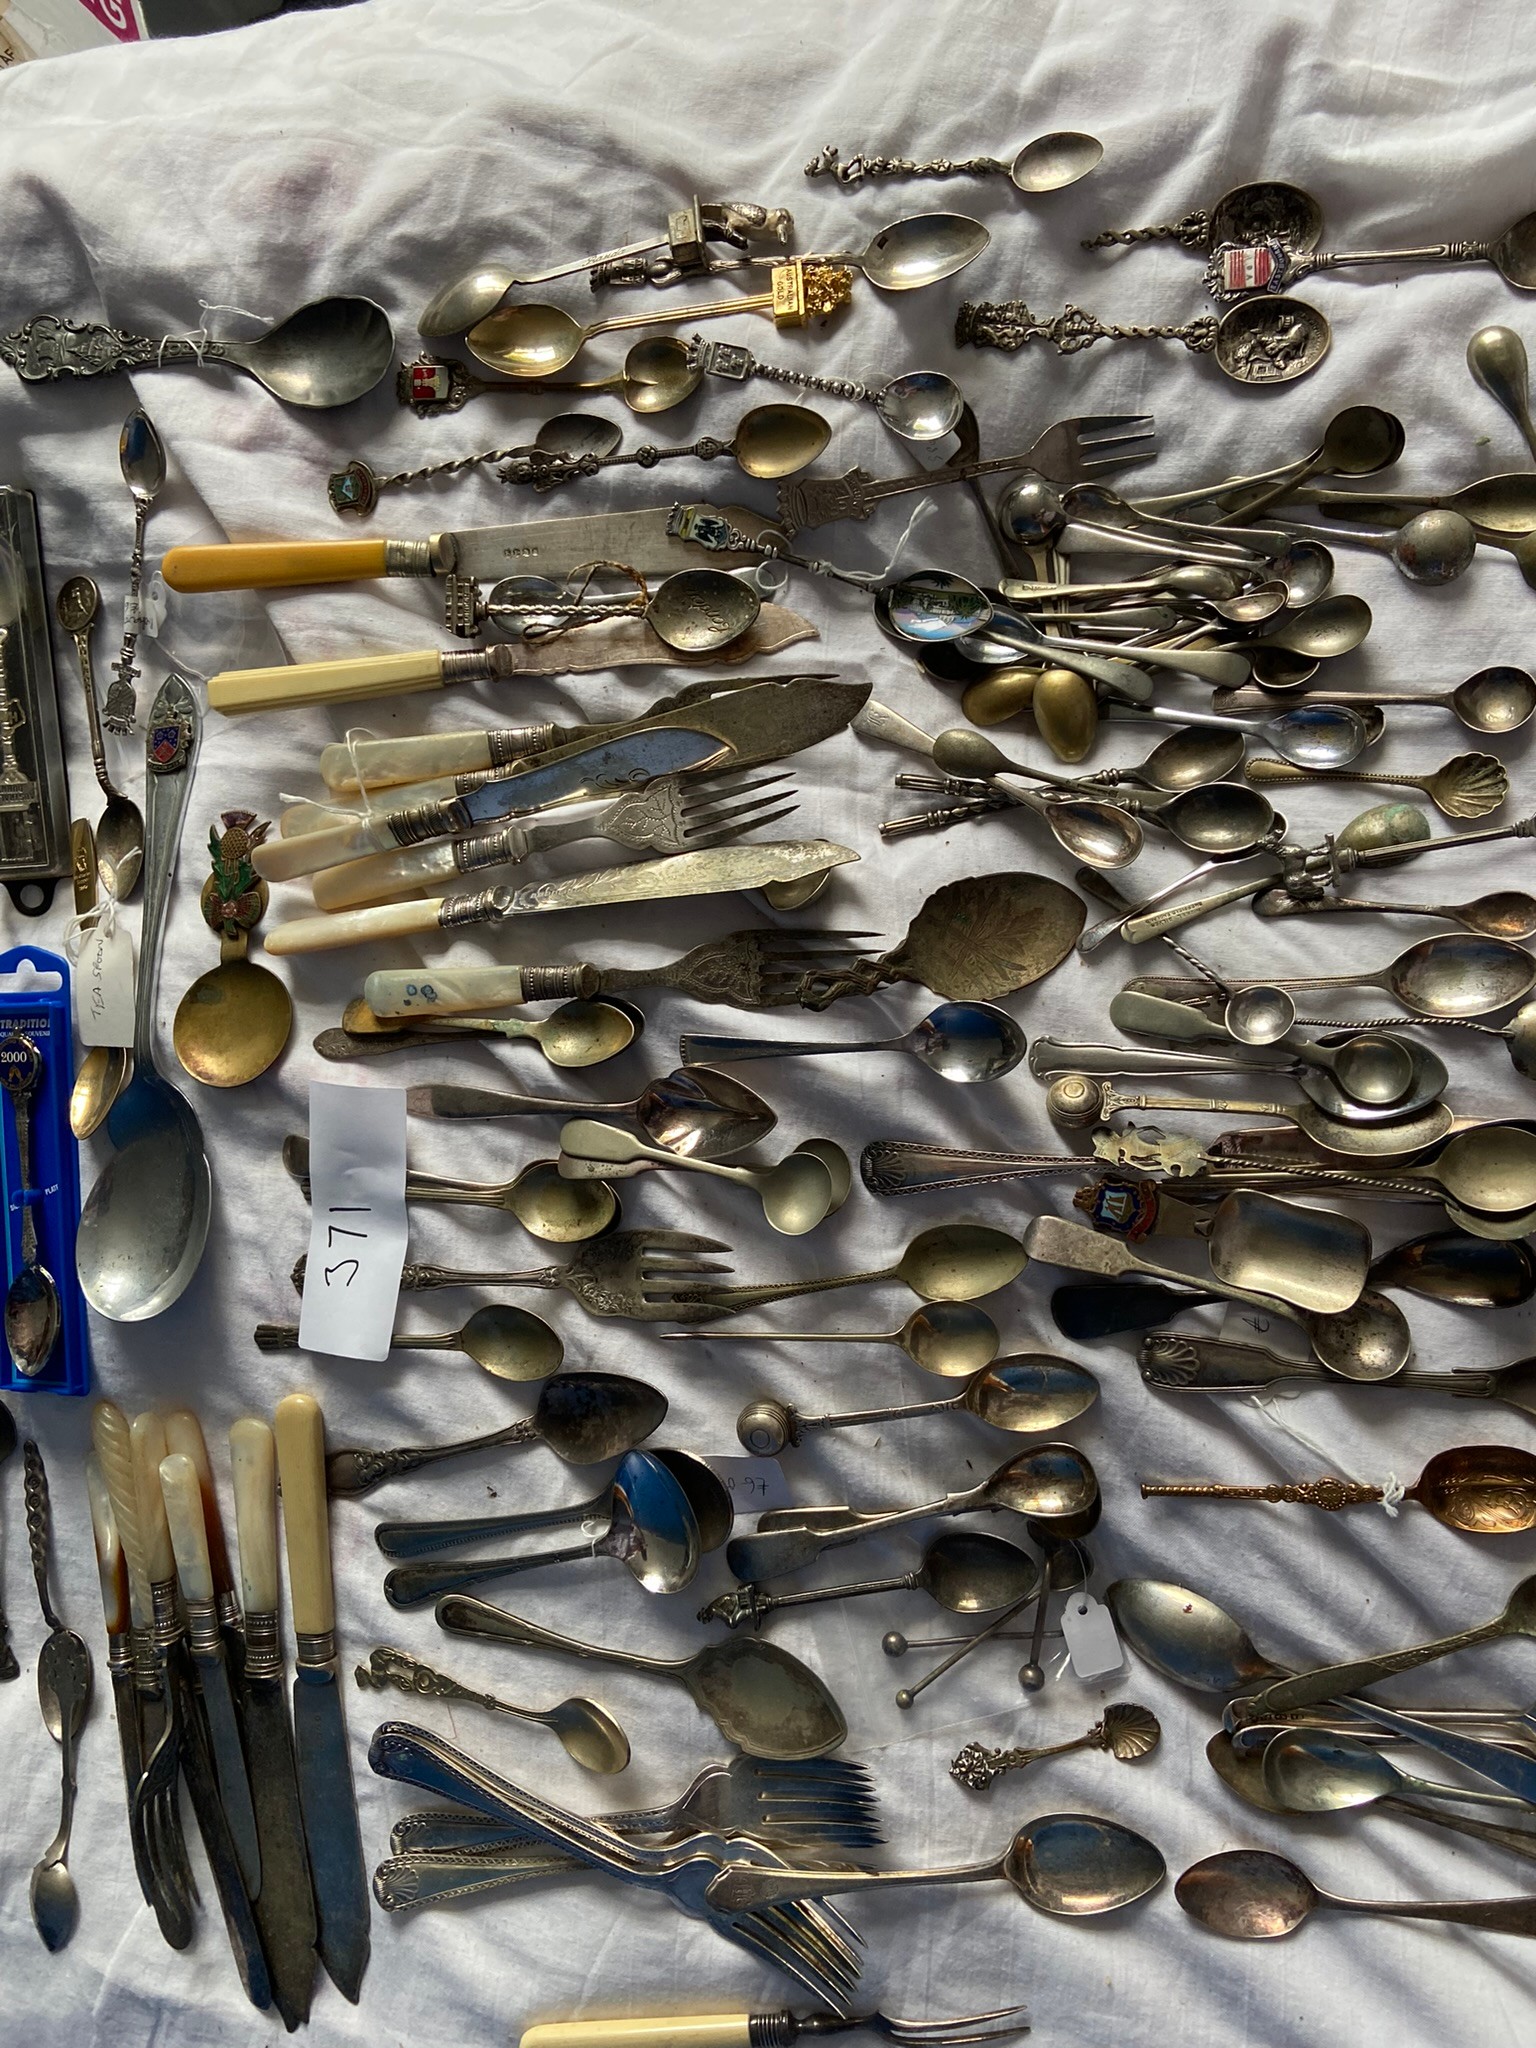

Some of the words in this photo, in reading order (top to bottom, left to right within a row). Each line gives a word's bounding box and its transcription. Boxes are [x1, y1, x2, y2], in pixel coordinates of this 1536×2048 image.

[777, 281, 785, 300] GOLD
[786, 268, 794, 310] AUSTRALIAN
[89, 987, 106, 1020] TEA
[1, 1051, 27, 1063] 2000
[323, 1206, 373, 1288] 371
